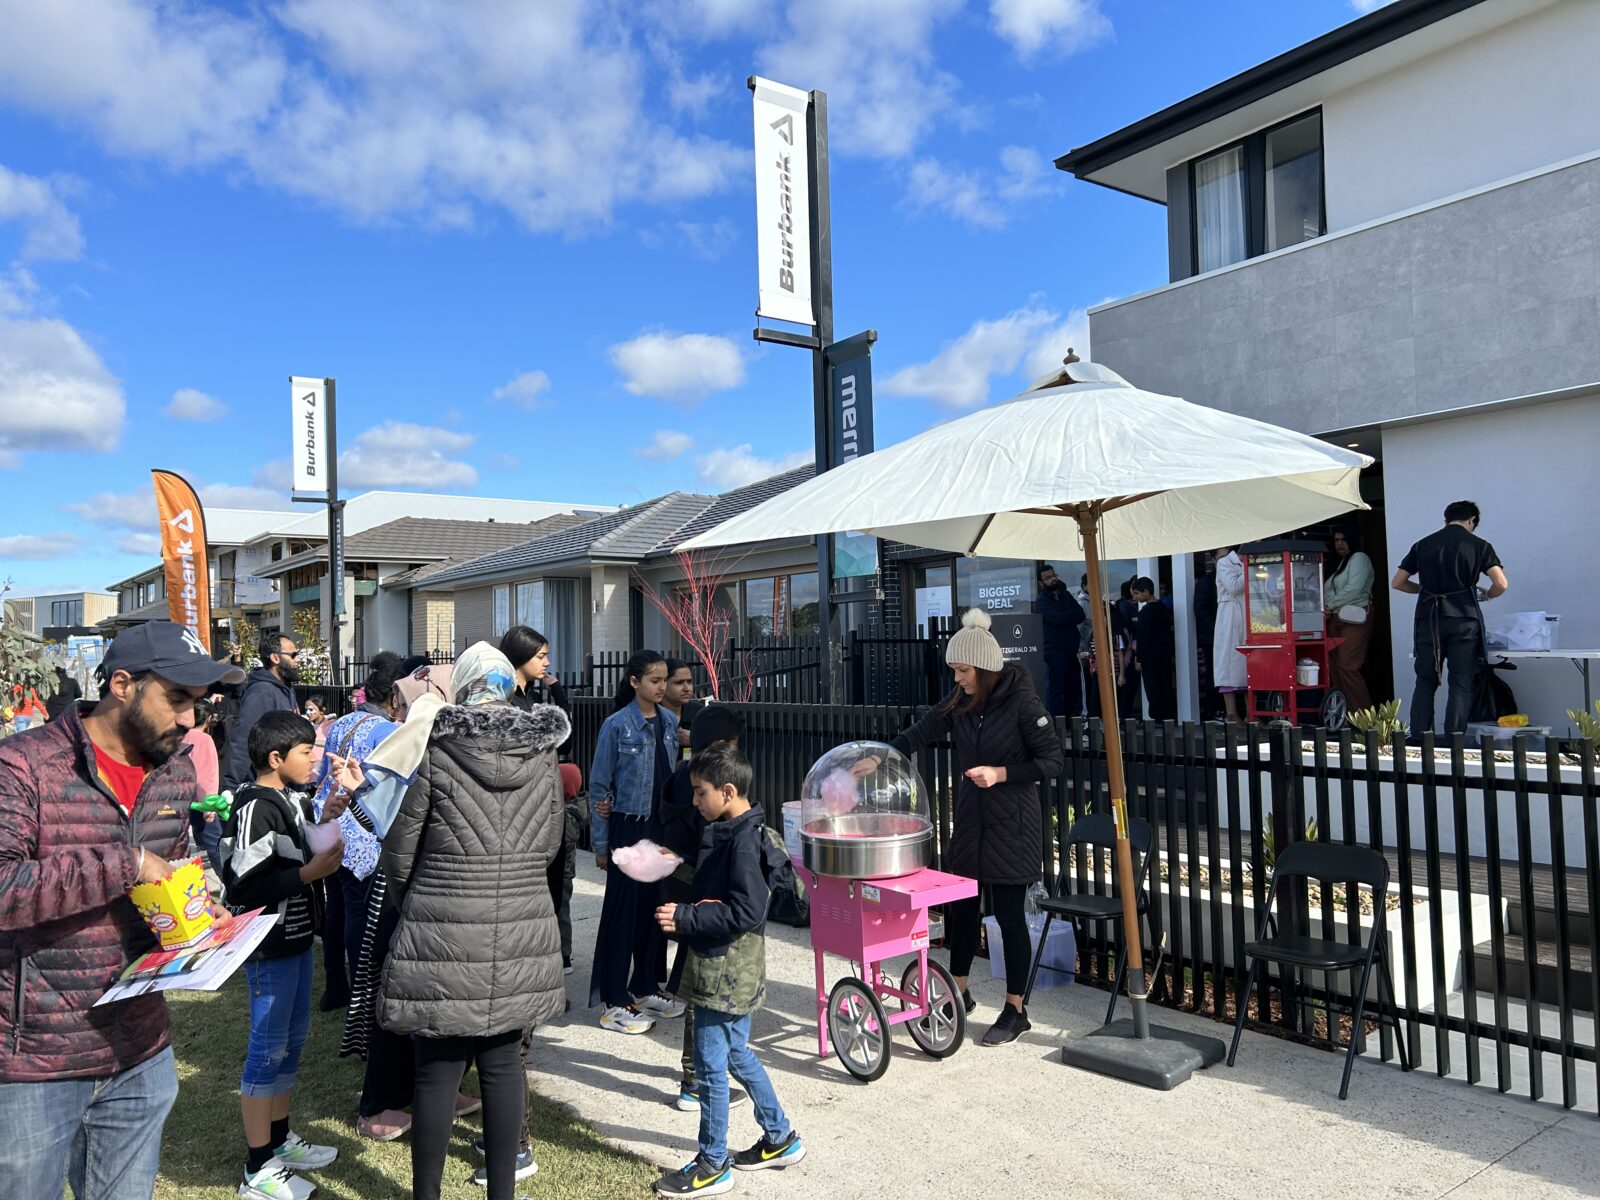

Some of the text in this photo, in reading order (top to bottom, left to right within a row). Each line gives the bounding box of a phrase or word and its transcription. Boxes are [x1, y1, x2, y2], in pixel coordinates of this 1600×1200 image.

[776, 152, 794, 293] Burbank
[842, 374, 858, 465] merri
[305, 410, 315, 477] Burbank
[979, 585, 1021, 598] BIGGEST
[987, 598, 1013, 609] DEAL
[1001, 646, 1028, 654] TZGERALD
